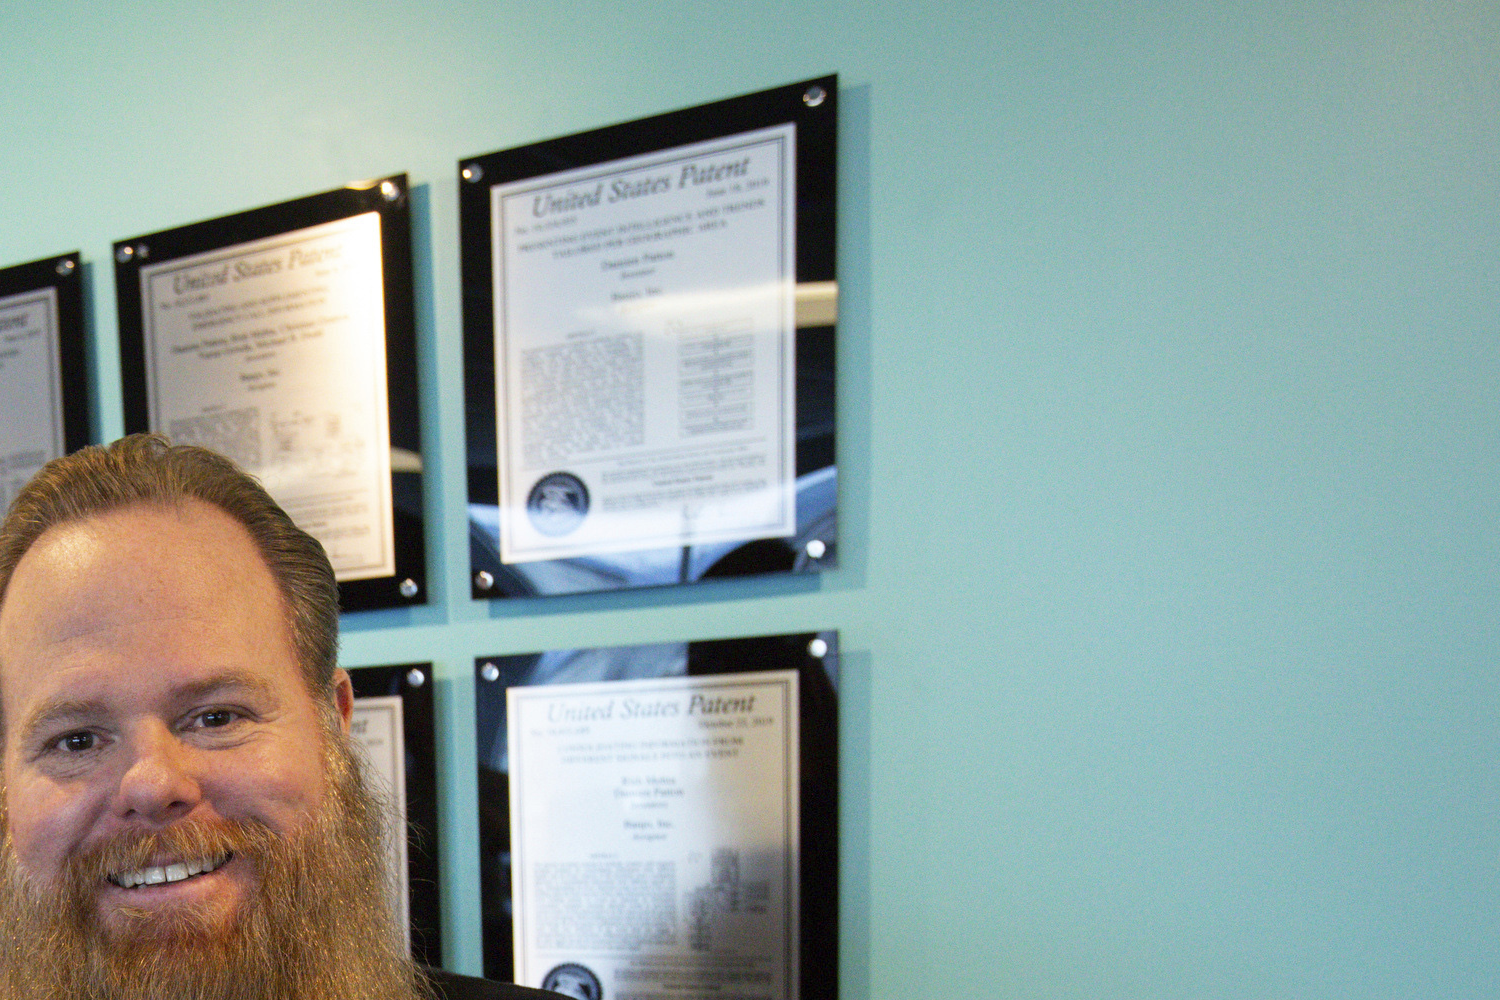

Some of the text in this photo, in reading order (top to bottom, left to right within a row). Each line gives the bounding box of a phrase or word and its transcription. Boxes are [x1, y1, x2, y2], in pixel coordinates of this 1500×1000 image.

[532, 158, 750, 217] United States Patent
[547, 693, 757, 723] United States Patent
